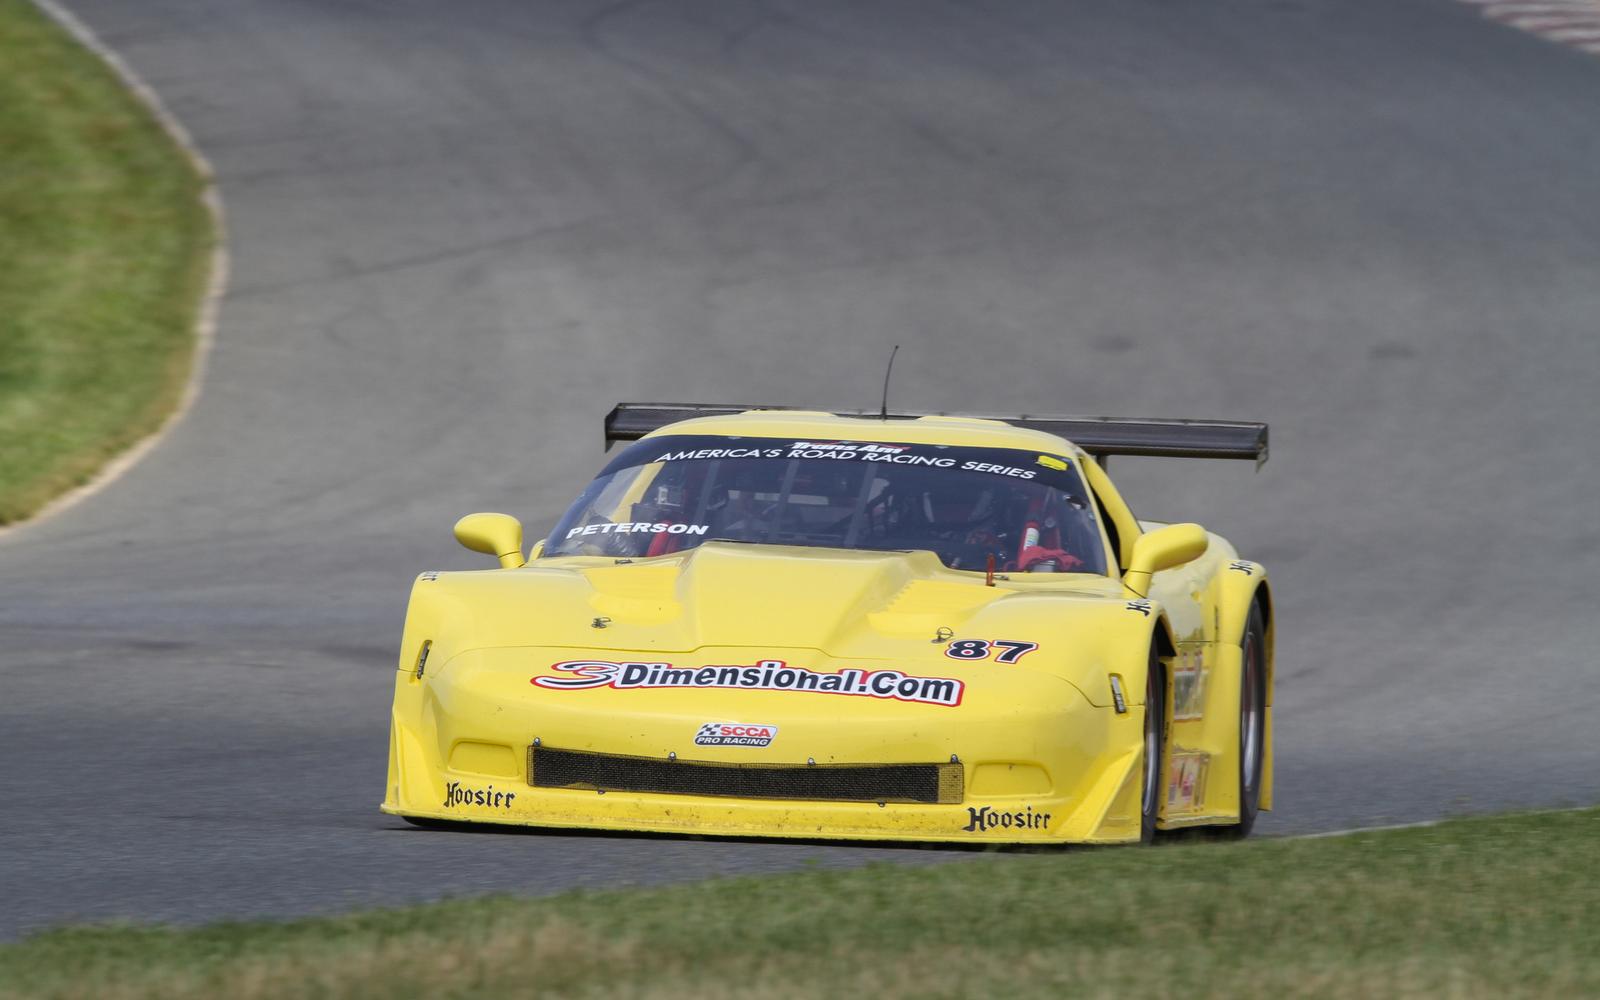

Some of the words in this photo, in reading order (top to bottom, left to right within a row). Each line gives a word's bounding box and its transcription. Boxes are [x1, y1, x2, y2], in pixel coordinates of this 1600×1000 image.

[791, 441, 859, 452] Trans
[857, 444, 904, 454] Am
[654, 448, 783, 463] AMERICA'S
[787, 449, 857, 460] ROAD
[862, 452, 957, 468] RACING
[961, 460, 1037, 480] SERIES
[565, 522, 710, 539] PETERSON
[945, 639, 1038, 664] 87
[533, 660, 961, 704] 3Dimensional.Com
[720, 726, 771, 738] SCCA
[722, 738, 769, 746] RACING
[443, 781, 516, 808] Hoosier
[962, 805, 1052, 832] Hoosier
